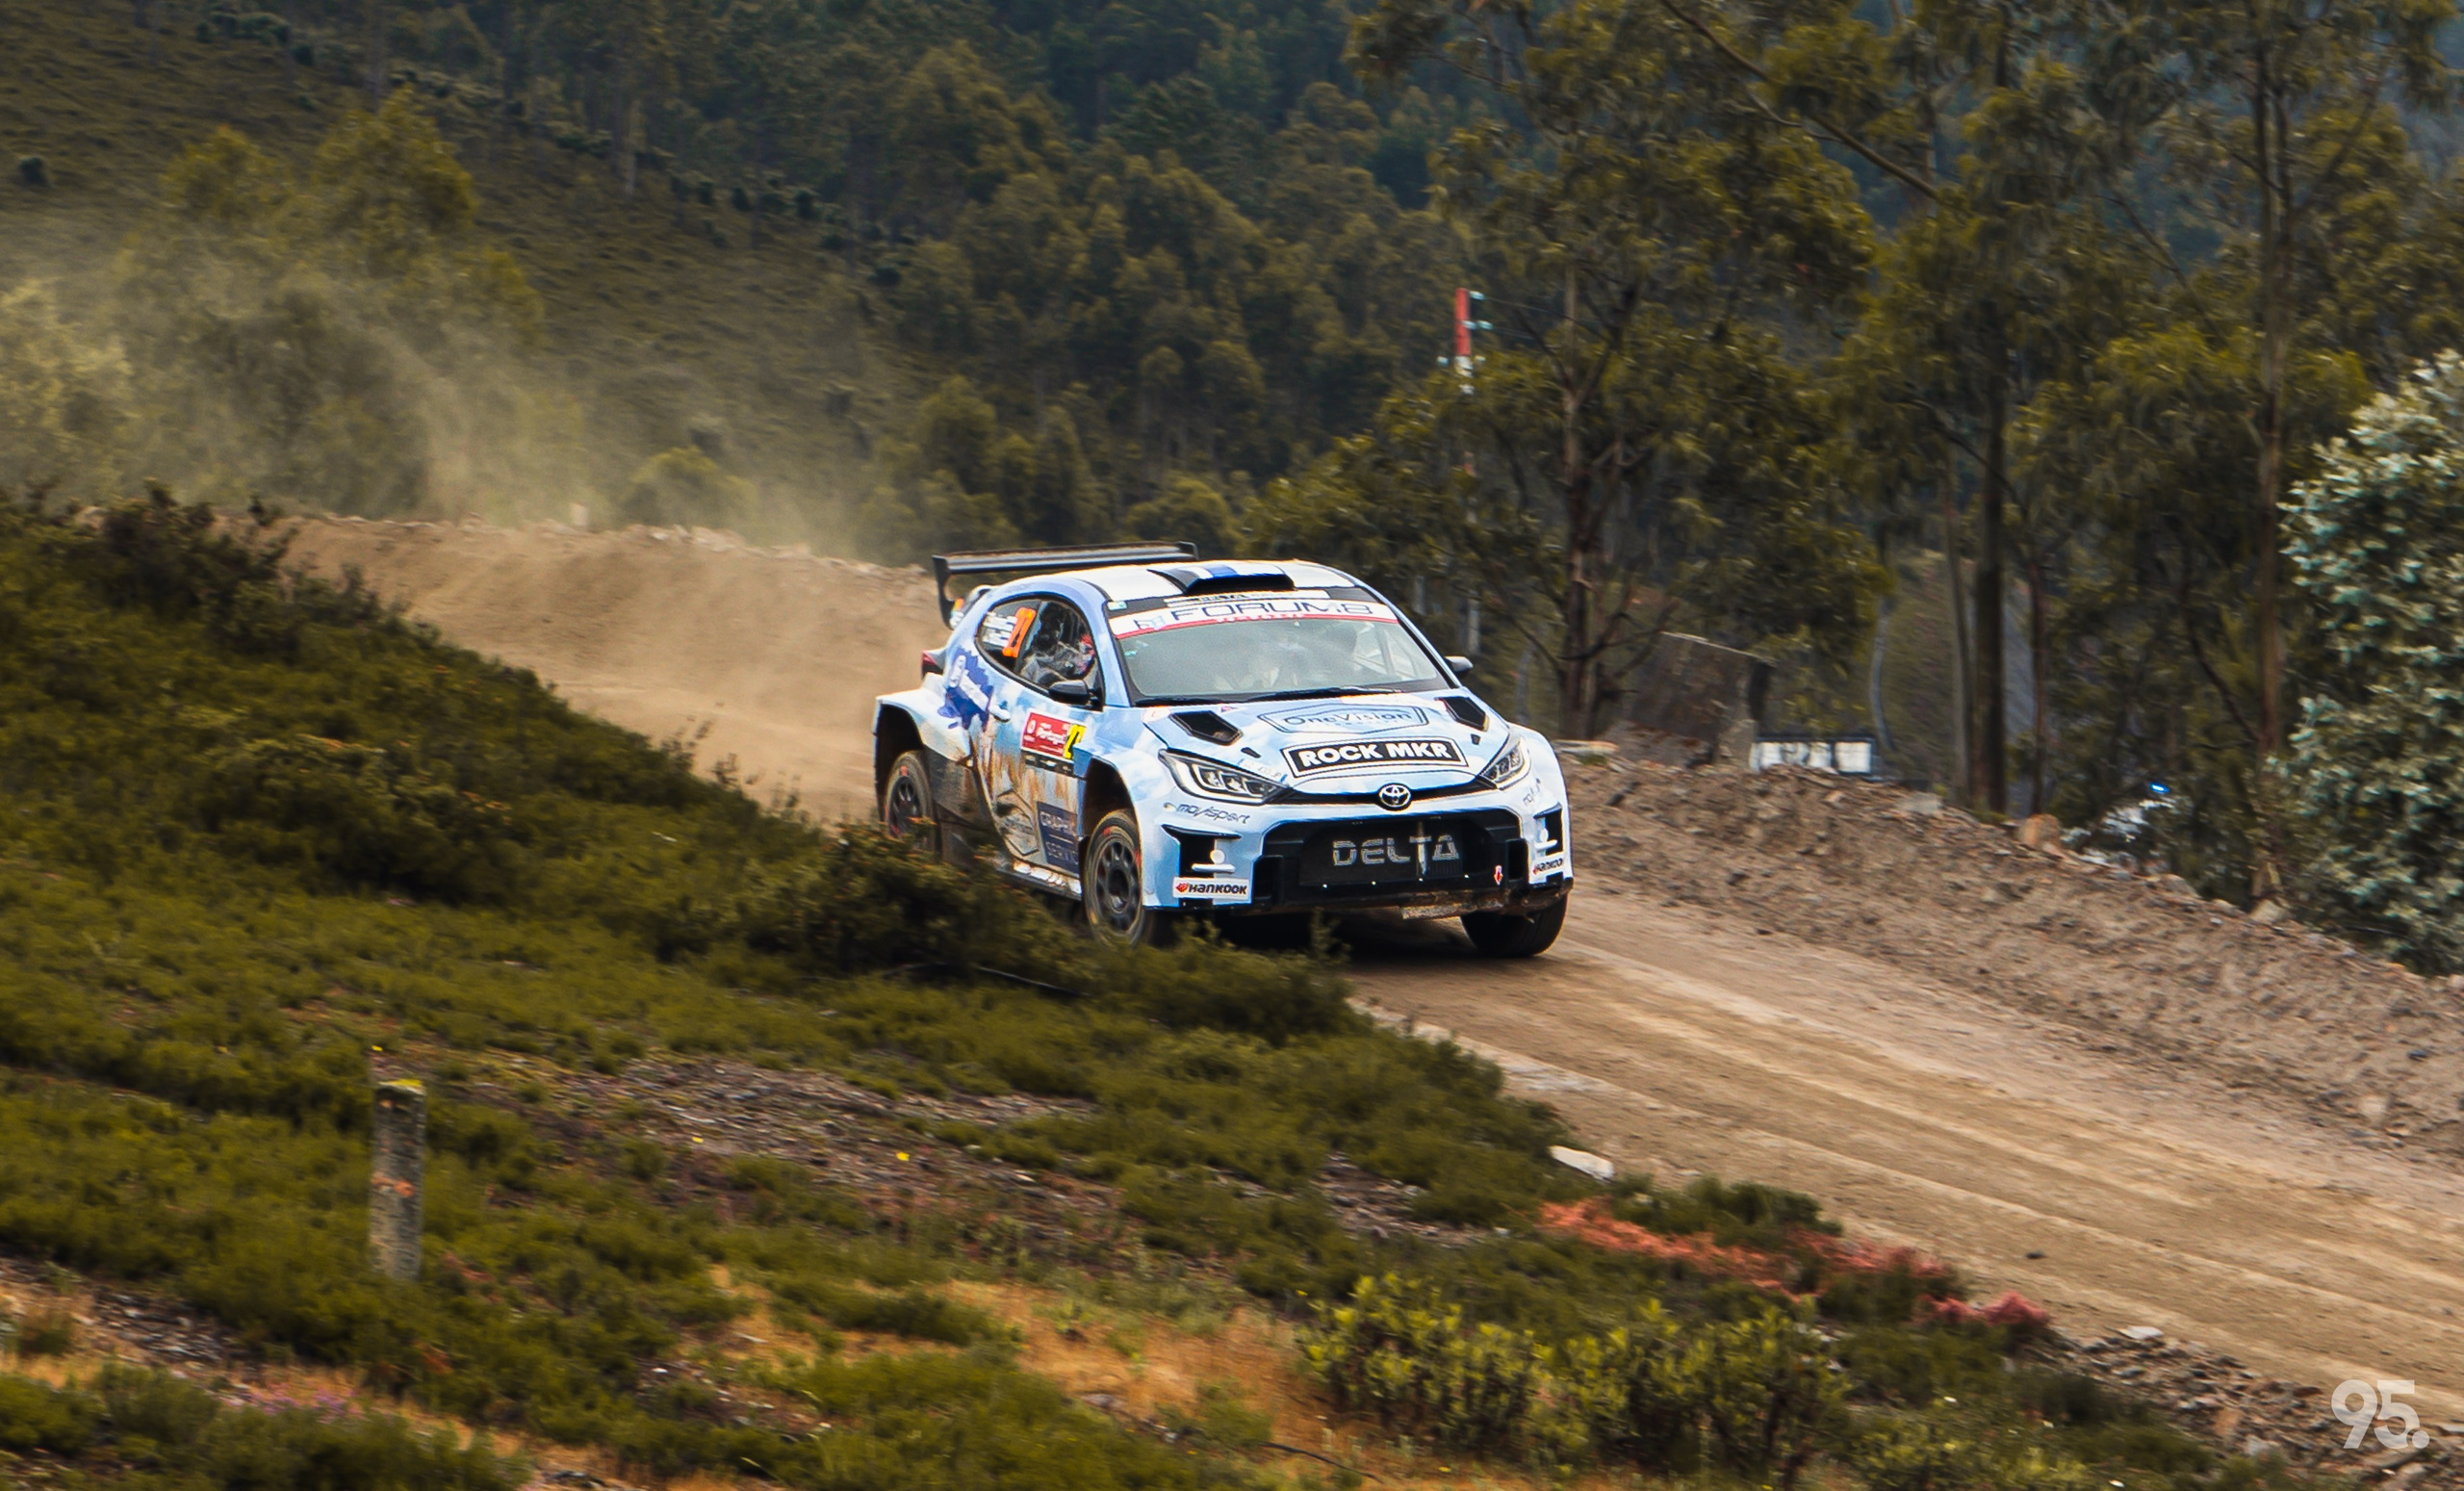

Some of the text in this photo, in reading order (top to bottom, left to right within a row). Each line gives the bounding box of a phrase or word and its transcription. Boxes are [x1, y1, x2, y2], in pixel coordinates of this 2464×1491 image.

[1170, 602, 1373, 621] FORUM8
[1002, 606, 1037, 658] 27
[1283, 711, 1412, 725] OneVision
[1297, 742, 1452, 768] ROCK MKR
[1332, 830, 1460, 874] DELTA
